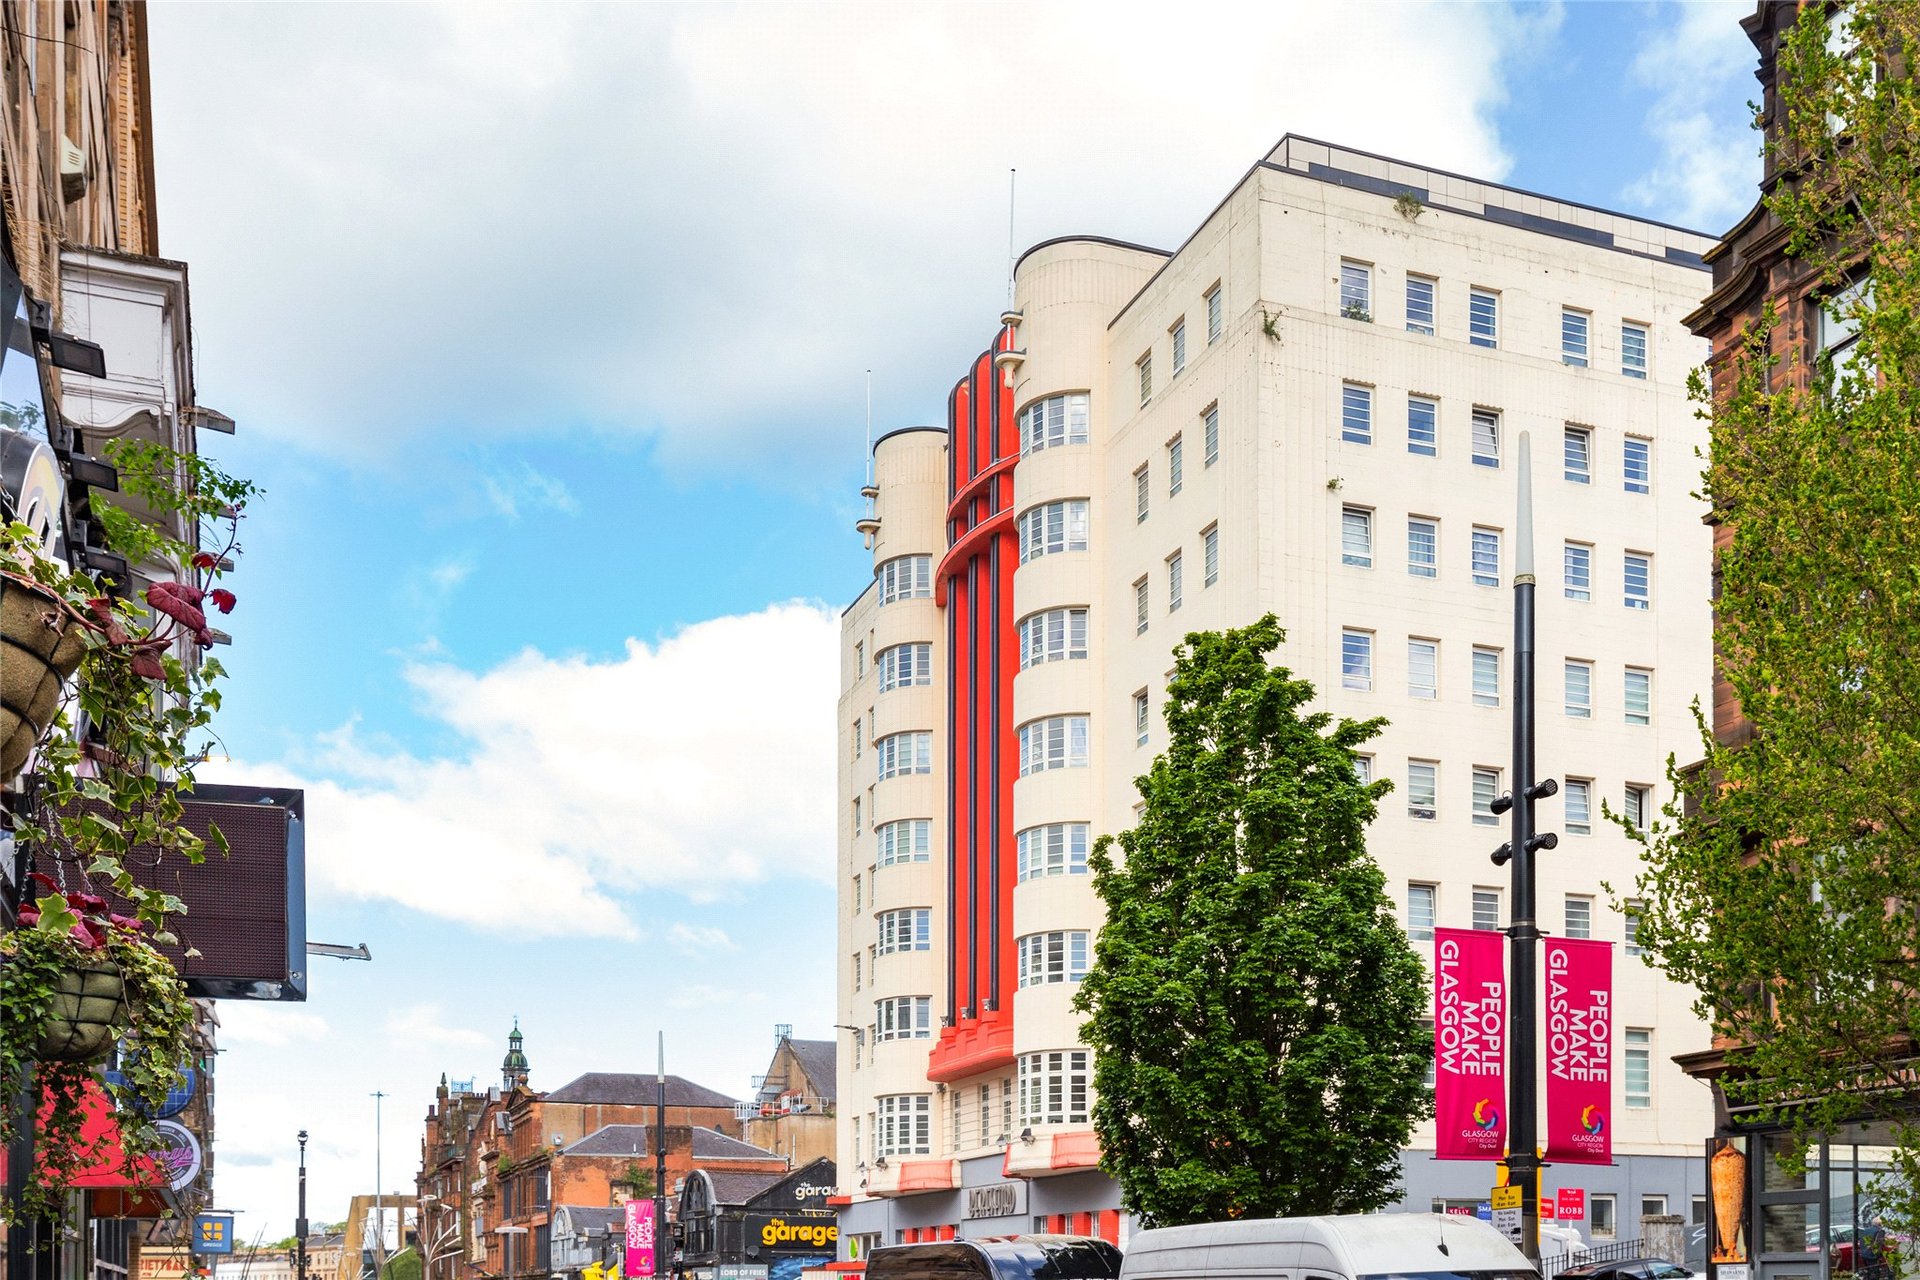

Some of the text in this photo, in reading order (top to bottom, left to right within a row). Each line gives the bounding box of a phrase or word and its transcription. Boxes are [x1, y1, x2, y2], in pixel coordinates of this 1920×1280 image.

[1440, 939, 1460, 1075] GLASGOW
[1549, 949, 1569, 1080] GLASGOW
[1461, 1000, 1480, 1075] MAKE
[1481, 981, 1501, 1076] PEOPLE
[1569, 1008, 1588, 1081] MAKE
[1589, 990, 1608, 1082] PEOPLE
[1462, 1130, 1499, 1138] GLASGOW
[1572, 1134, 1605, 1142] GLASGOW
[627, 1204, 637, 1249] GLASGOW
[771, 1218, 785, 1226] the
[1559, 1207, 1583, 1215] ROBB
[637, 1223, 645, 1249] MAKE
[644, 1216, 653, 1249] PEOPLE
[762, 1224, 837, 1247] garage
